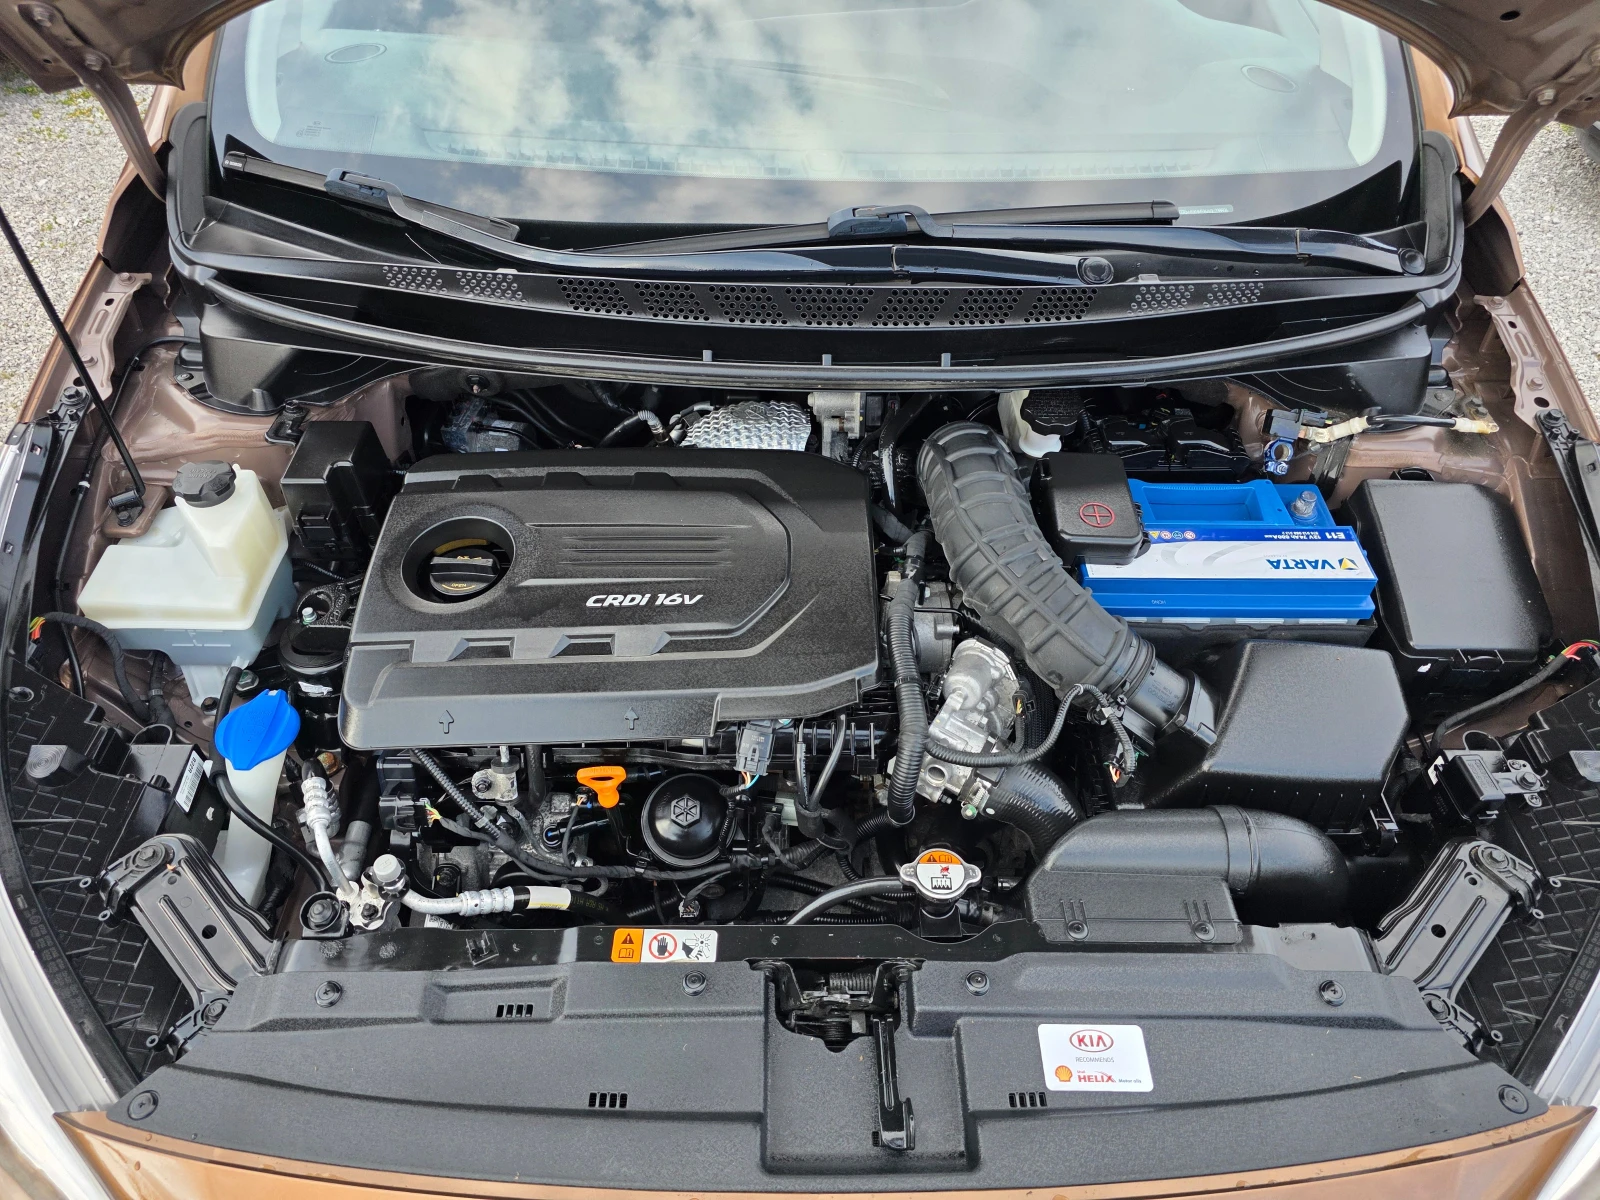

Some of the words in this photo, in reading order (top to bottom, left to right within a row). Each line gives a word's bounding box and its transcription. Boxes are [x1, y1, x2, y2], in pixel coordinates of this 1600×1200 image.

[1325, 531, 1345, 540] E11
[1265, 559, 1336, 570] VARTA
[586, 594, 651, 607] CRDi
[655, 593, 703, 606] 16V
[1076, 1034, 1108, 1048] KIA
[1077, 1073, 1116, 1083] HELIX
